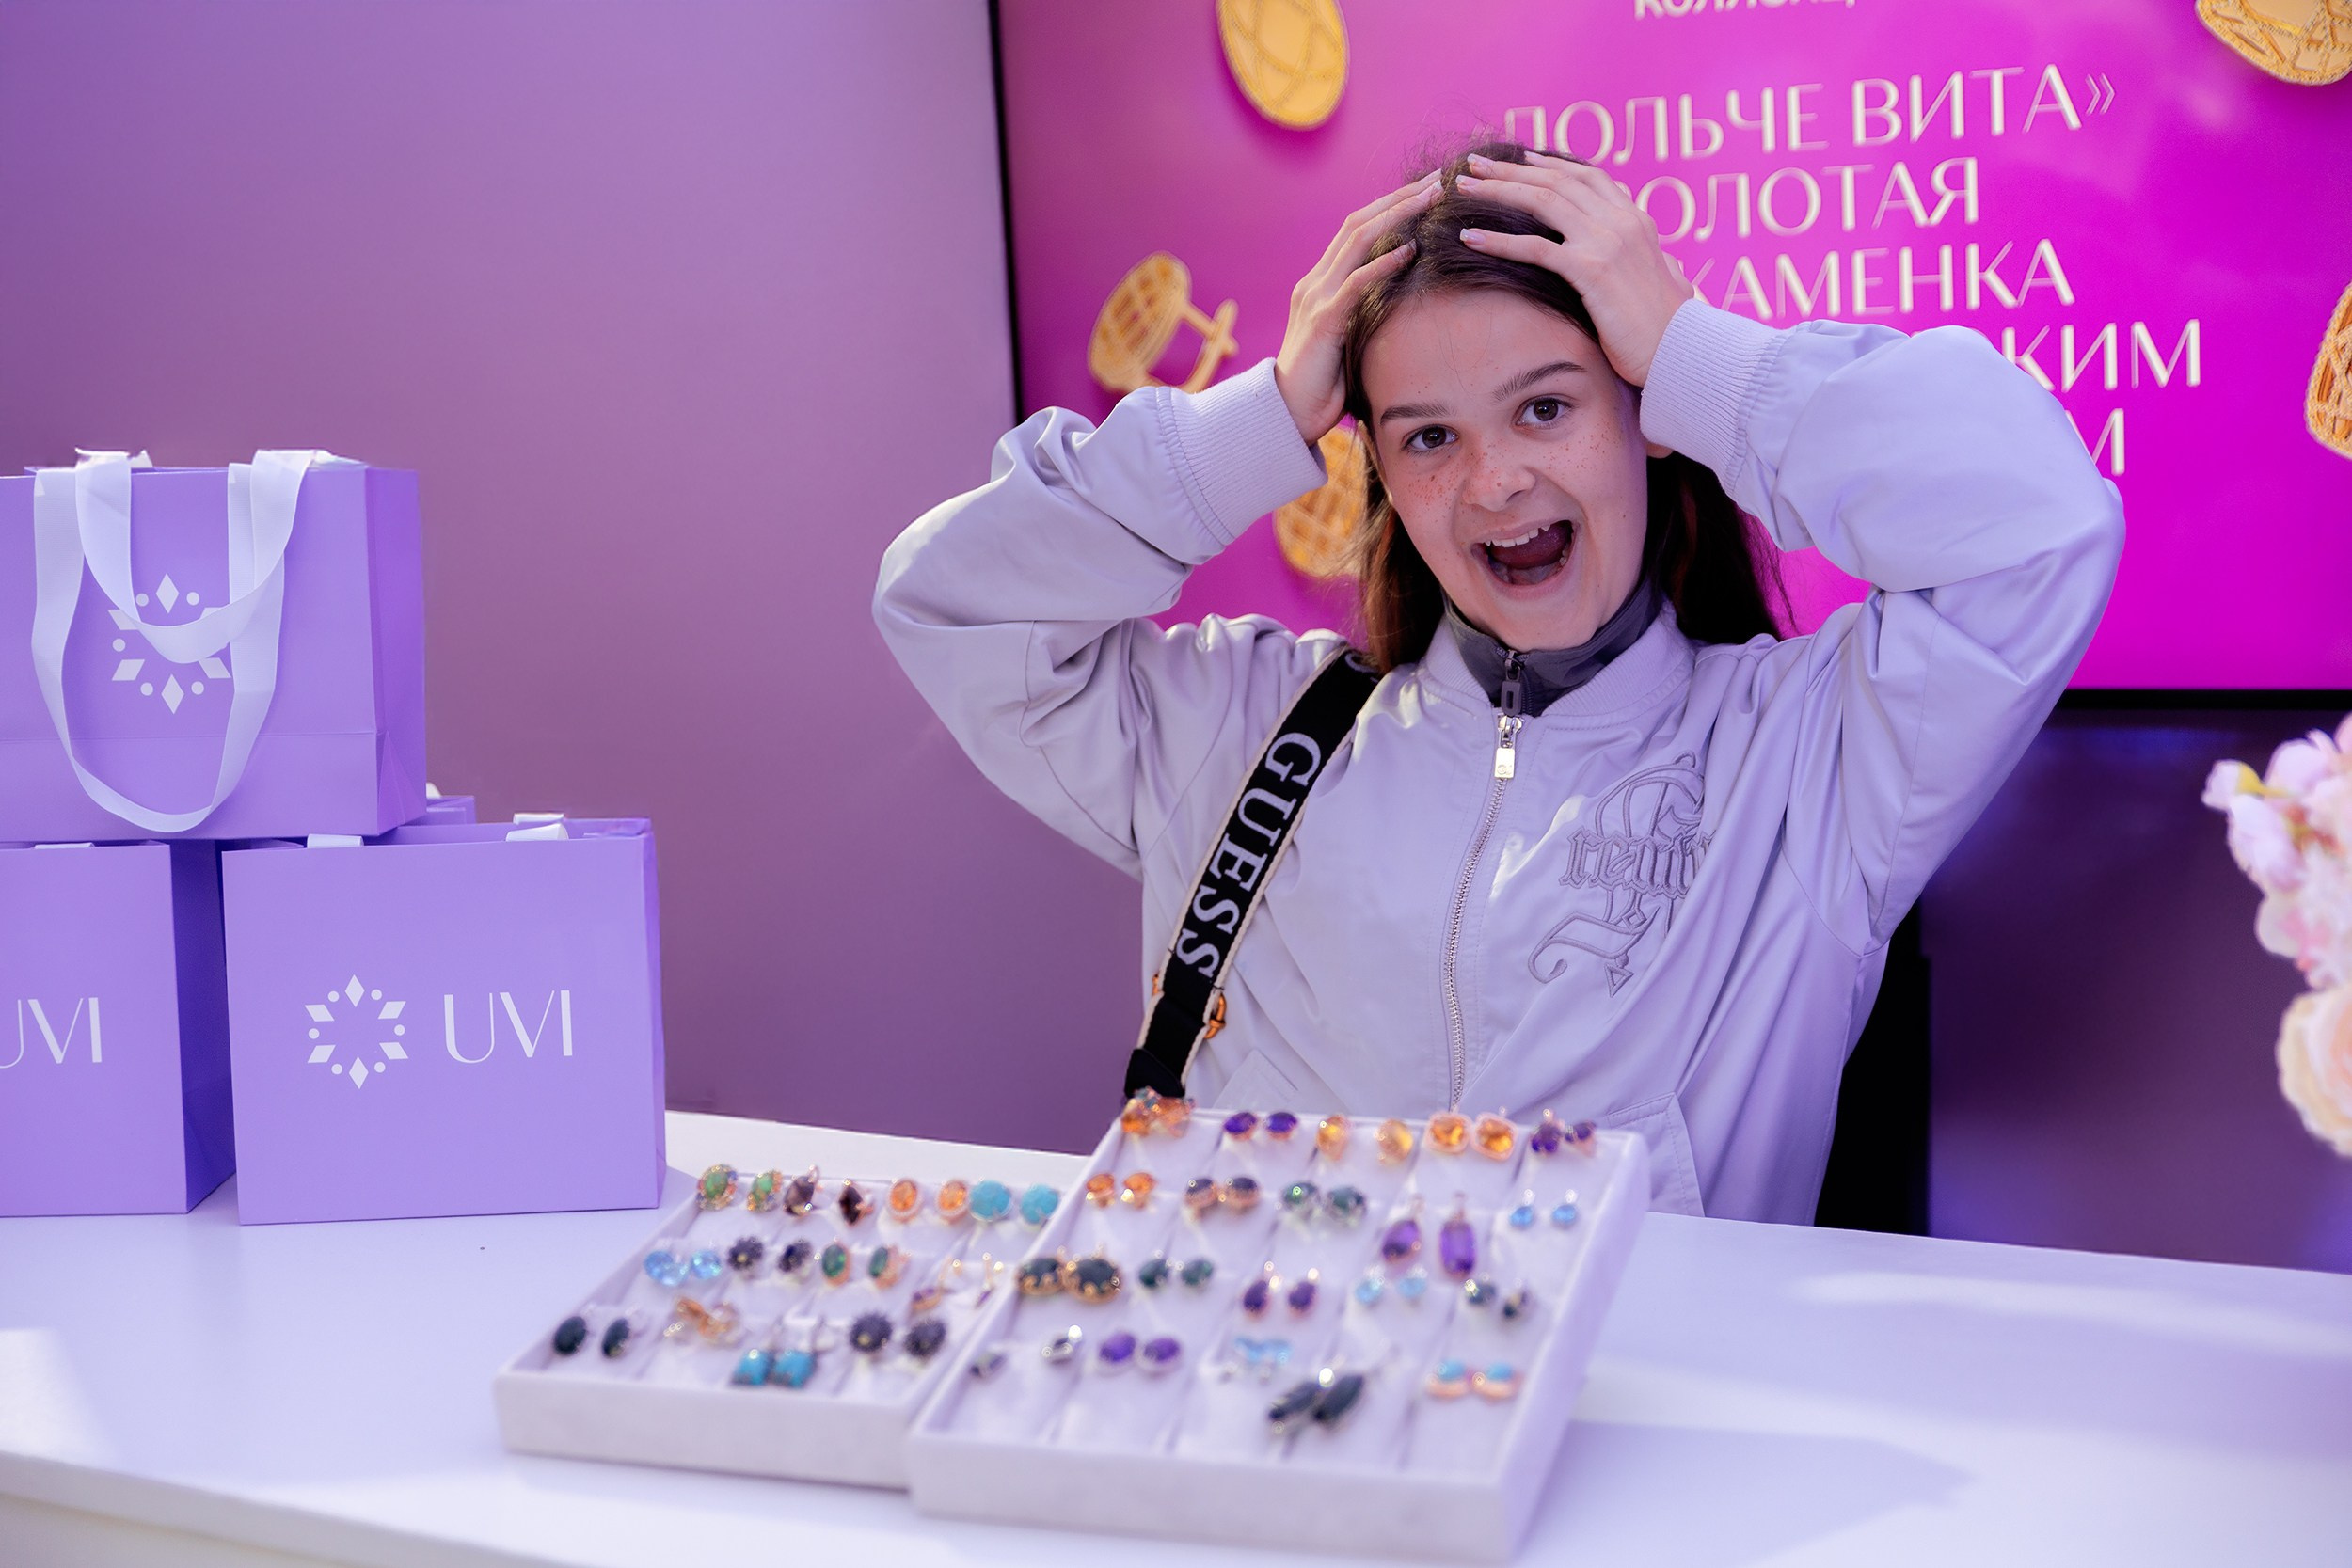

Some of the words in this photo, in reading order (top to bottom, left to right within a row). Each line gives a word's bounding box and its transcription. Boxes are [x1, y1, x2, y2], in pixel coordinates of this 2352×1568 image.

[1851, 63, 2117, 148] ВИТА»
[1613, 156, 1979, 244] ОЛОТАЯ
[1175, 731, 1322, 979] GUESS
[443, 990, 573, 1064] UVI
